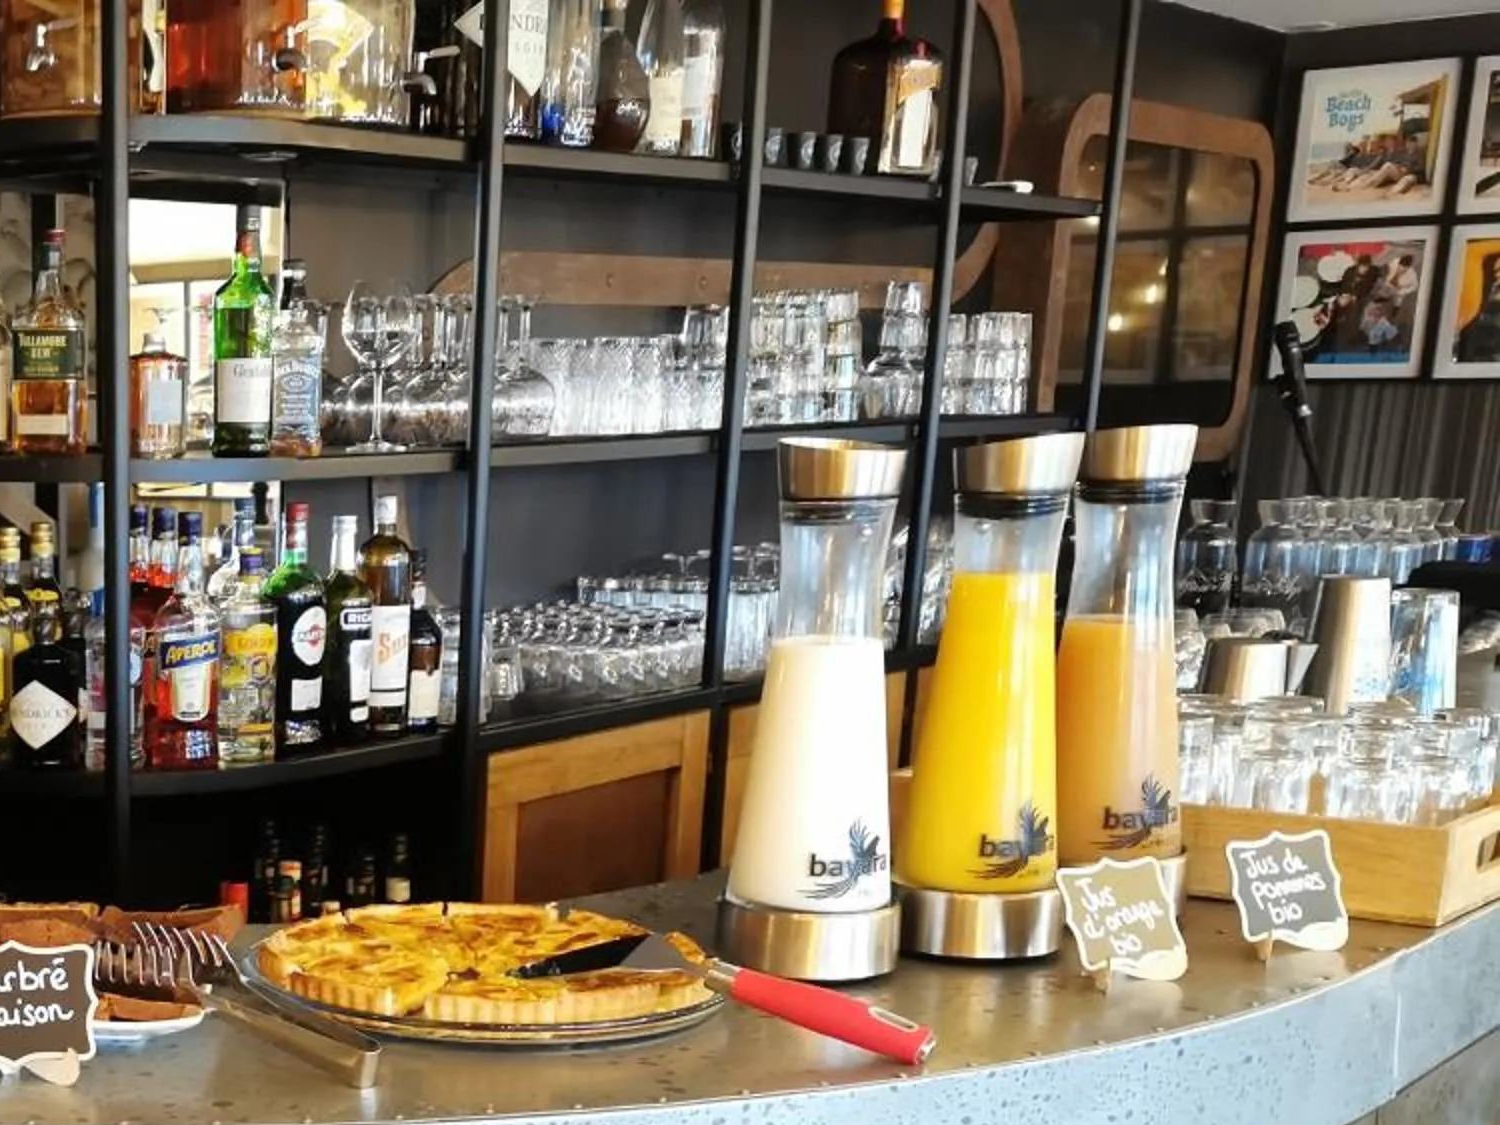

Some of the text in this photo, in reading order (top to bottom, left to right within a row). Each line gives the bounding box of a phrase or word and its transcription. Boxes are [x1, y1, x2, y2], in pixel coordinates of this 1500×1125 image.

[1329, 112, 1364, 131] Boys
[166, 640, 216, 665] APEROL
[1240, 847, 1308, 879] Jus de
[1074, 877, 1117, 913] Jus
[1267, 899, 1303, 925] bio
[1109, 931, 1142, 956] bio
